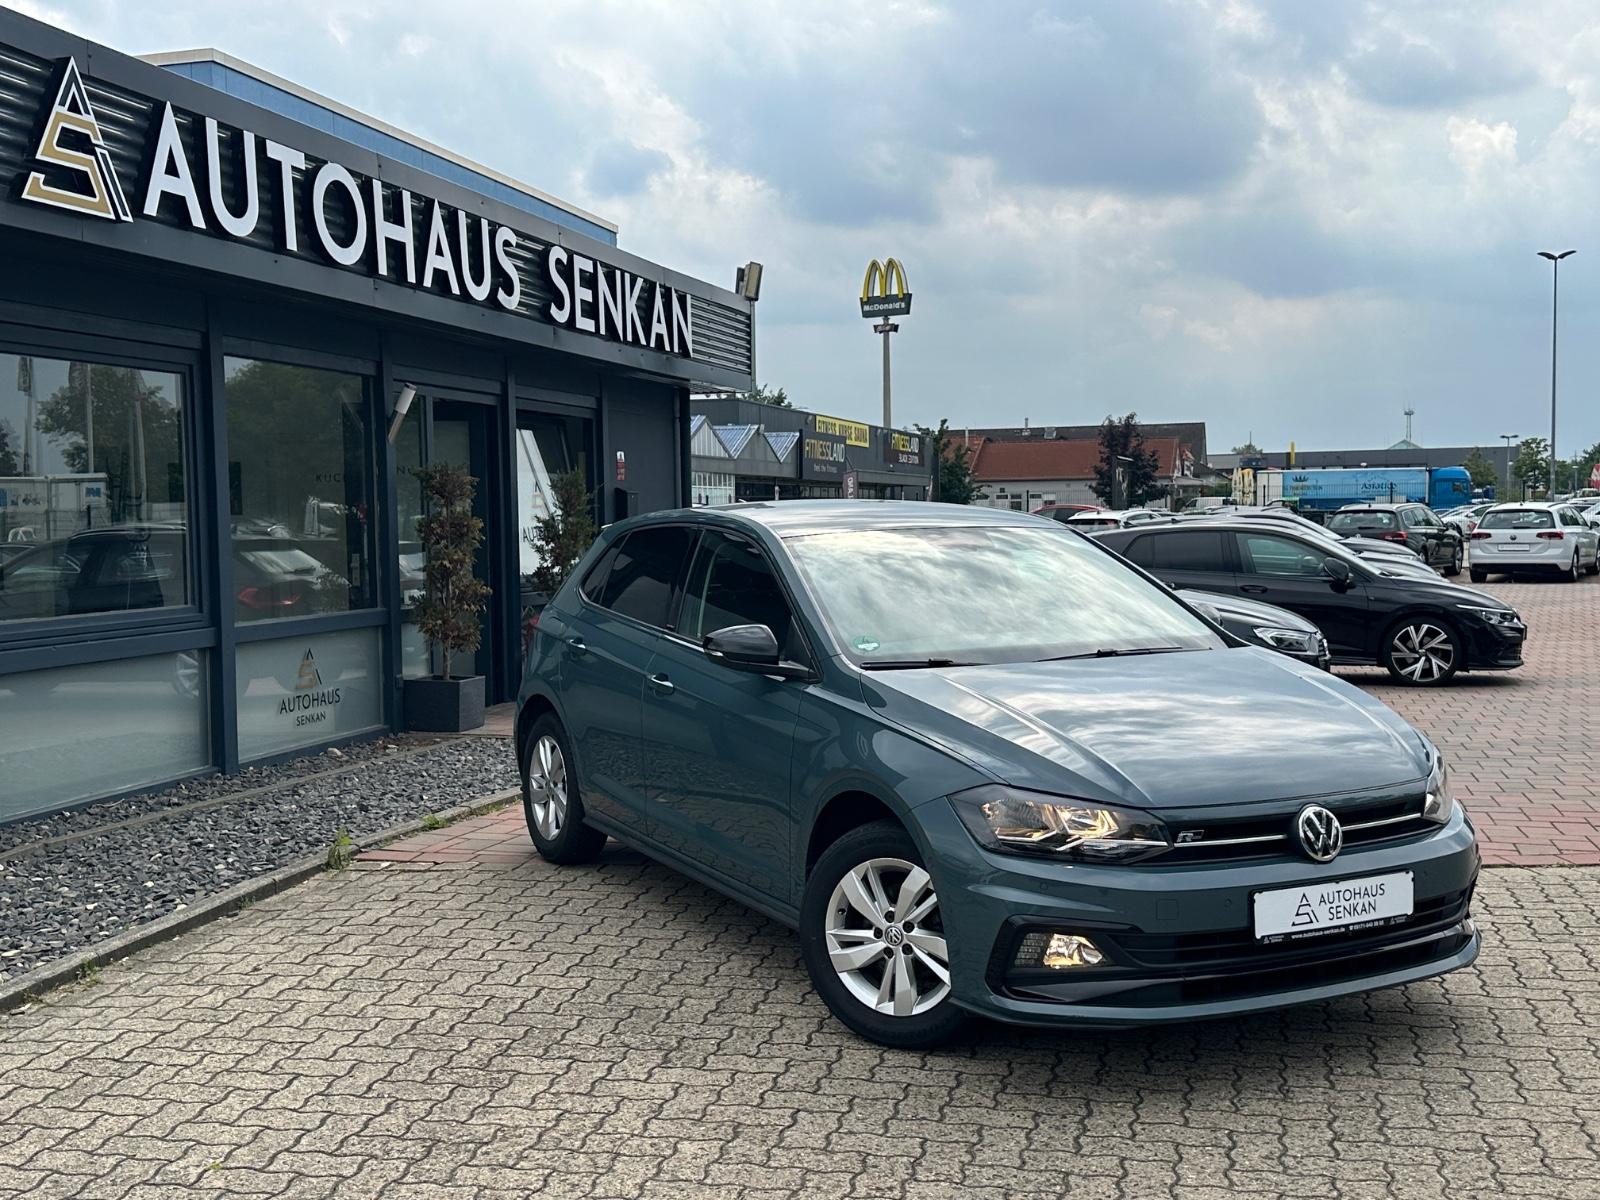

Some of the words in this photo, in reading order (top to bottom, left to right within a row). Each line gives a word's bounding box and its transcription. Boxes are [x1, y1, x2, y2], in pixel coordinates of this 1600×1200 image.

[143, 101, 521, 311] AUTOHAUS
[549, 245, 694, 359] SENKAN
[863, 301, 906, 312] McDonald's
[804, 438, 845, 463] FITNESSLAND
[891, 433, 919, 453] FITNESSLAND
[280, 688, 341, 714] AUTOHAUS
[296, 711, 326, 726] SENKAN
[1319, 883, 1385, 906] AUTOHAUS
[1328, 899, 1377, 921] SENKAN
